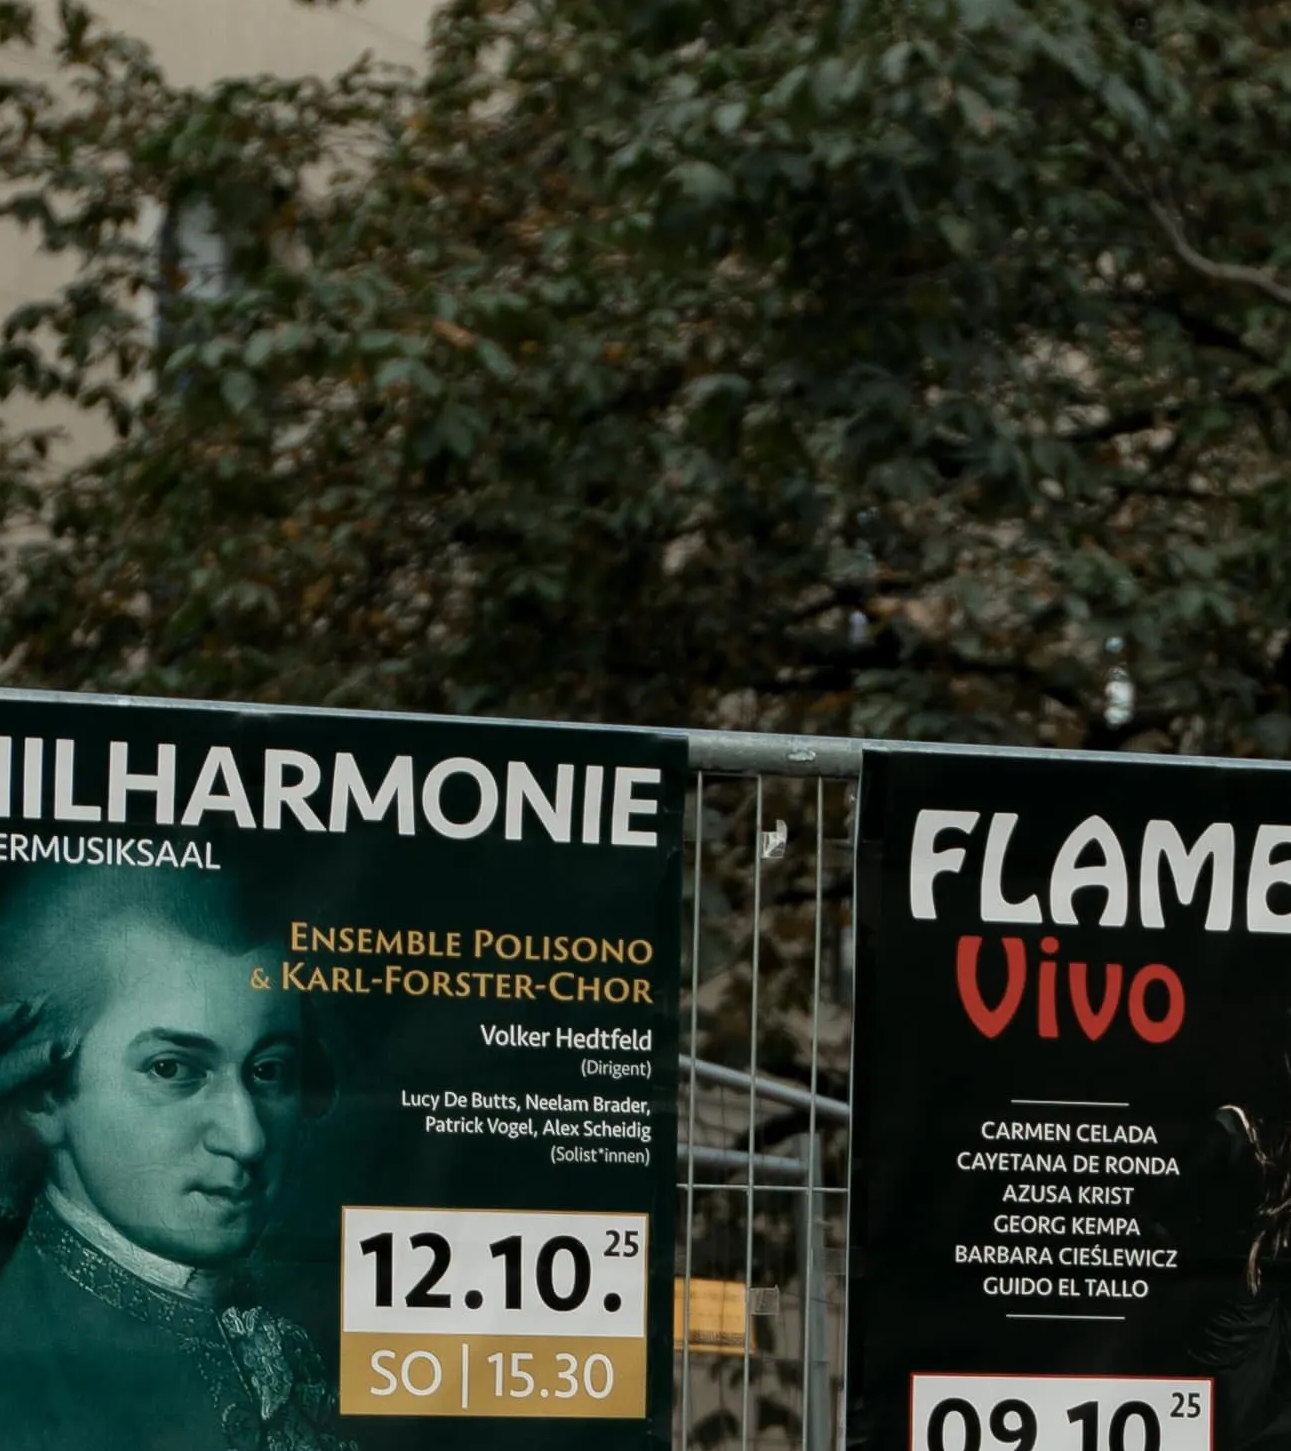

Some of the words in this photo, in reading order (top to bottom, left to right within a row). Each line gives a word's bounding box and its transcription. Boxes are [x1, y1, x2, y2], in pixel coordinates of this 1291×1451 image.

[250, 966, 269, 991] &
[480, 1024, 551, 1047] Volker
[556, 1027, 652, 1051] Hedtfeld
[581, 1058, 652, 1080] (Dirigent)
[401, 1090, 440, 1111] Lucy
[444, 1091, 468, 1108] De
[471, 1091, 521, 1112] Butts,
[525, 1093, 589, 1112] Neelam
[593, 1095, 651, 1117] Brader,
[425, 1115, 484, 1134] Patrick
[486, 1117, 538, 1139] Vogel,
[542, 1118, 580, 1137] Alex
[583, 1120, 652, 1143] Scheidig
[981, 1121, 1071, 1142] CARMEN
[1076, 1123, 1158, 1144] CELADA
[957, 1151, 1068, 1173] CAYETANA
[1073, 1154, 1100, 1173] DE
[1105, 1155, 1180, 1176] RONDA
[1002, 1184, 1073, 1204] AZUSA
[1078, 1185, 1135, 1205] KRIST
[993, 1214, 1066, 1235] GEORG
[1072, 1216, 1141, 1236] KEMPA
[955, 1244, 1054, 1265] BARBARA
[1058, 1243, 1178, 1268] CIEŚLEWICZ
[983, 1276, 1053, 1296] GUIDO
[1058, 1278, 1081, 1297] EL
[1084, 1278, 1149, 1298] TALLO
[370, 1349, 442, 1396] SO
[487, 1352, 614, 1399] 15.30
